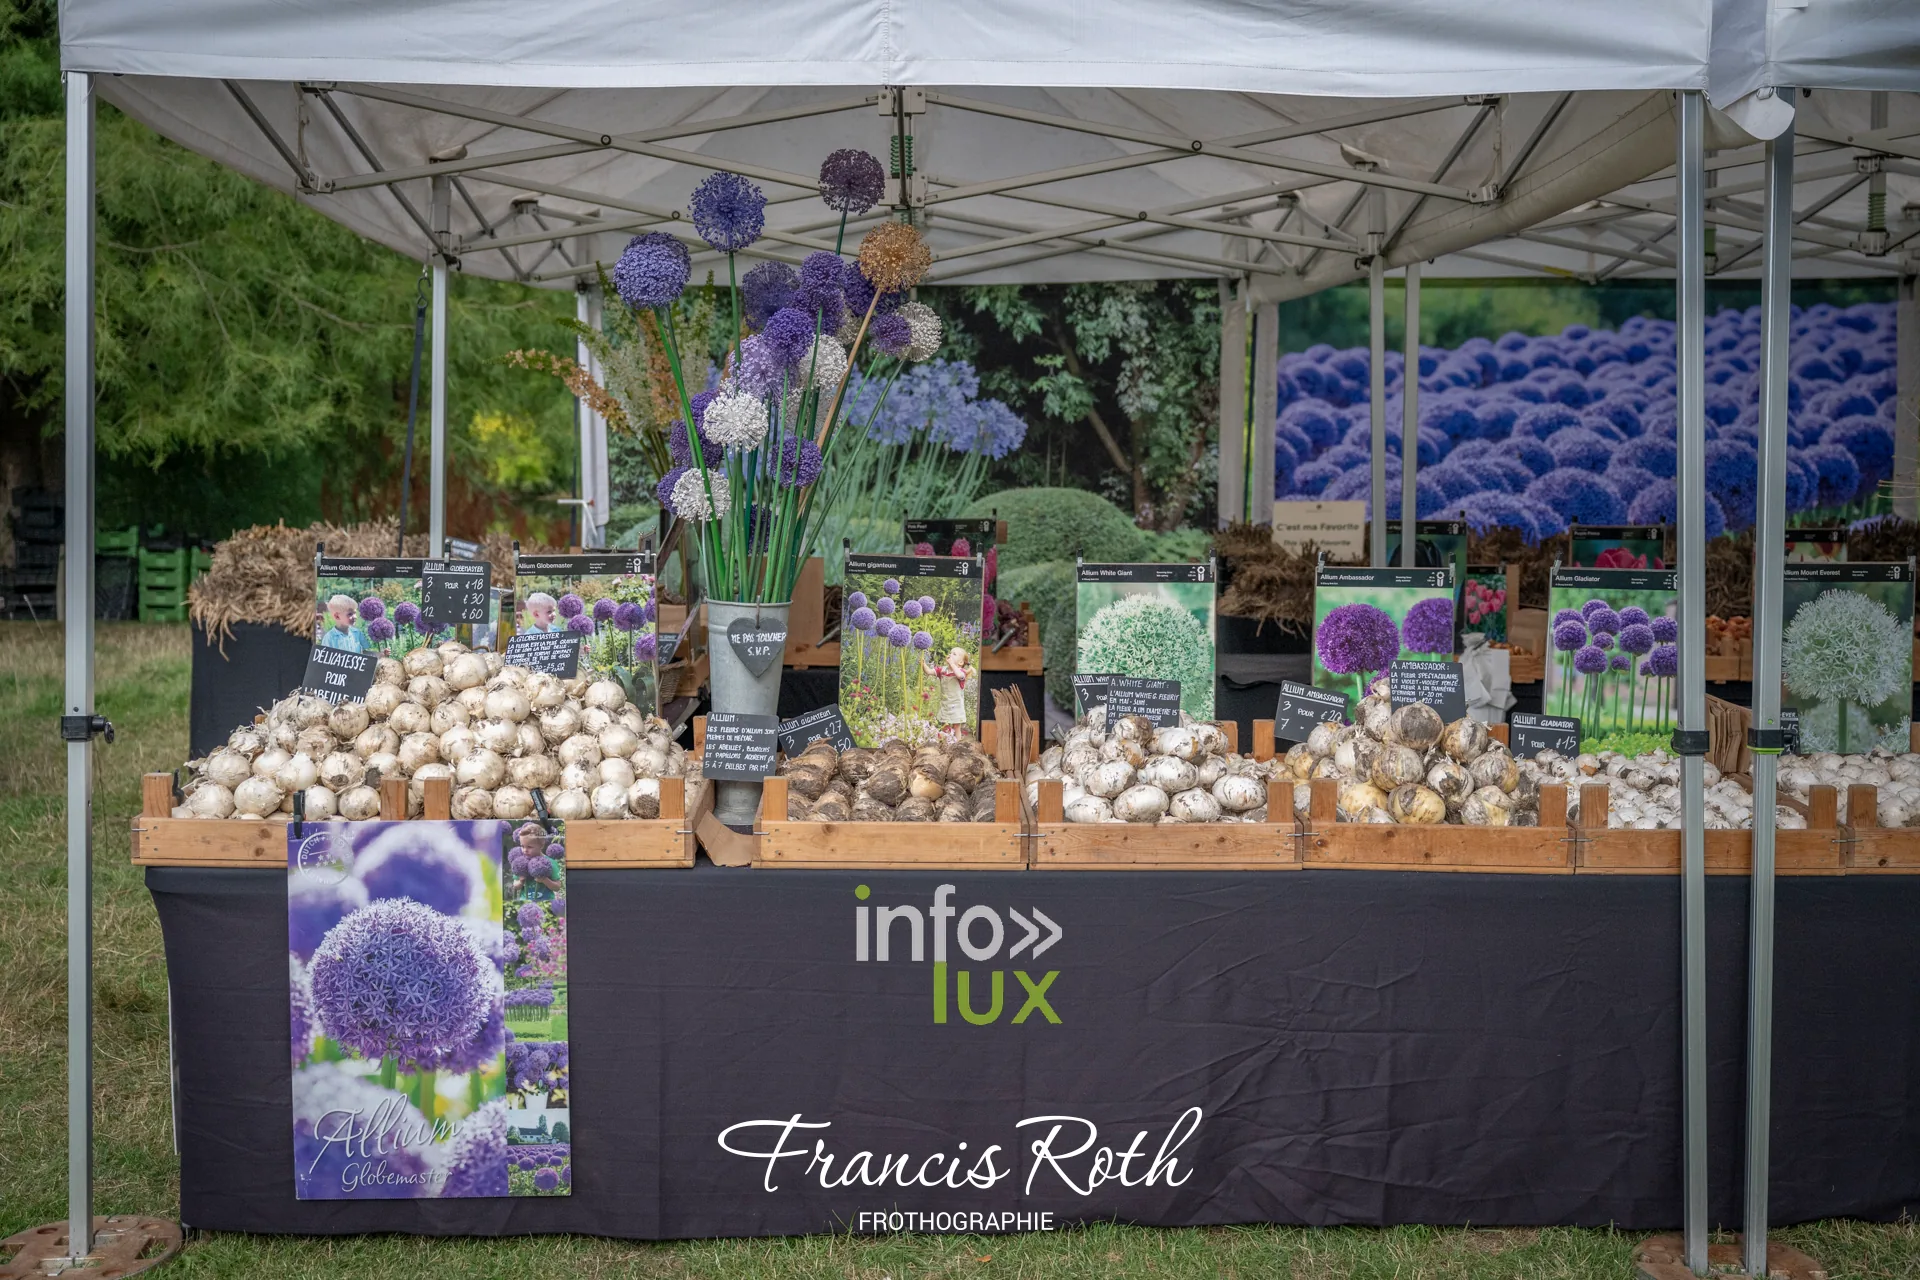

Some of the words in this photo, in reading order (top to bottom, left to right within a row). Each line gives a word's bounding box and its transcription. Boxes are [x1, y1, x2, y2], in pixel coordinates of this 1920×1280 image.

[1320, 522, 1360, 531] Favorite
[319, 564, 338, 572] Allium
[339, 564, 376, 572] Globemaster
[423, 562, 445, 572] ALLIUM
[449, 565, 484, 573] GLOBEMASTER
[517, 562, 536, 570] Allium
[536, 561, 573, 570] Globemaster
[867, 562, 897, 570] giganteum
[426, 576, 434, 589] 3
[444, 581, 459, 590] POUR
[1573, 575, 1601, 583] Gladiator
[424, 591, 431, 603] 6
[422, 605, 434, 618] 12
[730, 633, 741, 644] NE
[742, 632, 755, 644] PAS
[756, 631, 787, 643] TOUCHER
[747, 645, 771, 656] S.V.P.
[312, 647, 368, 672] DÉLICATESSE
[324, 671, 348, 687] POUR
[1073, 675, 1095, 683] ALLIUM
[1081, 687, 1090, 701] 3
[1282, 683, 1305, 696] ALLIUM
[1306, 689, 1345, 704] AMBASSADOR
[1282, 700, 1292, 711] 3
[1297, 707, 1315, 718] POUR
[777, 719, 800, 733] ALLIUM
[800, 709, 832, 726] GIGANTEUM
[1280, 718, 1290, 731] 7
[1512, 715, 1537, 725] ALLIUM
[1540, 719, 1575, 729] GLADIATOR
[706, 725, 718, 733] LES
[720, 726, 740, 734] FLEURS
[741, 727, 764, 735] D'ALLIUM
[706, 733, 725, 741] PLEINES
[785, 735, 795, 750] 3
[1518, 733, 1525, 747] 4
[1530, 740, 1546, 749] POUR
[744, 753, 768, 761] ADORENT
[704, 760, 710, 769] 5
[717, 761, 723, 769] 7
[724, 762, 747, 771] BULBES
[748, 763, 759, 772] PAR
[301, 836, 320, 861] DUTCH
[309, 1093, 464, 1174] Allium
[341, 1159, 453, 1192] Globemaster
